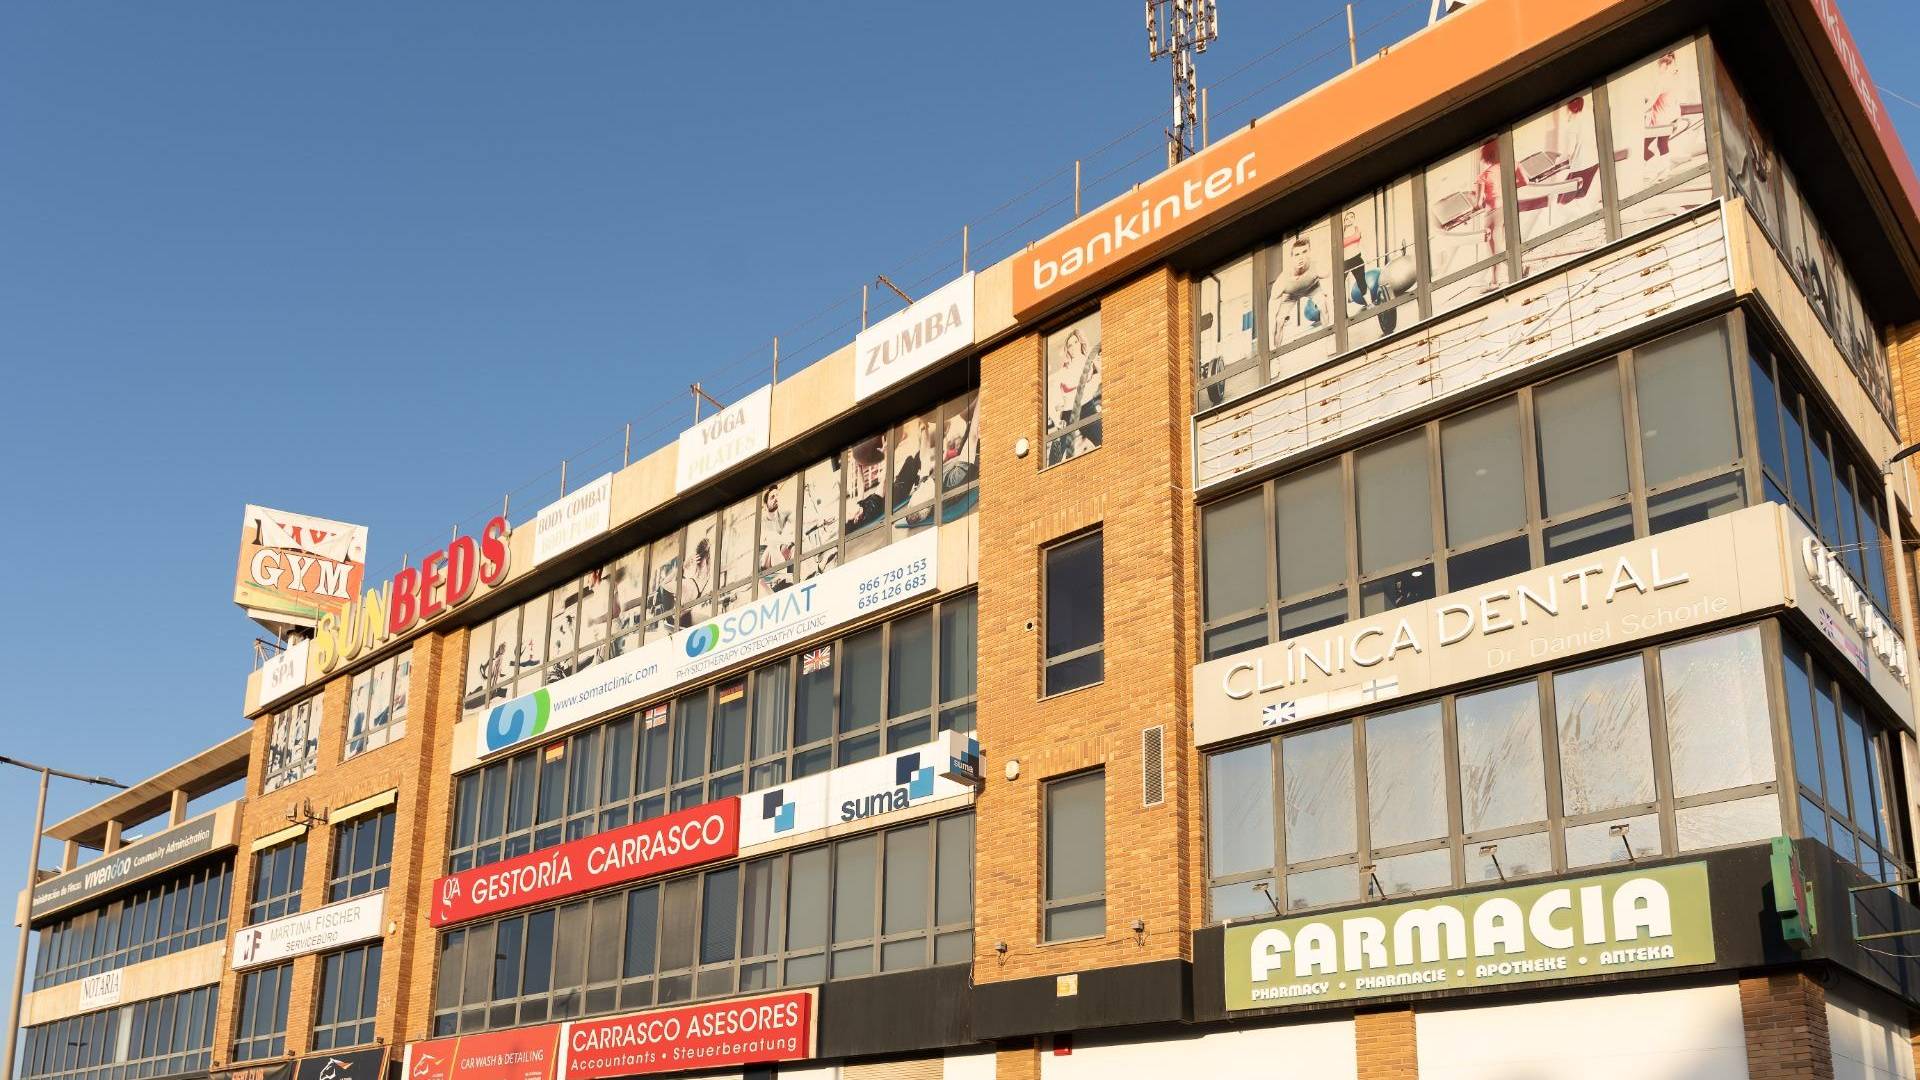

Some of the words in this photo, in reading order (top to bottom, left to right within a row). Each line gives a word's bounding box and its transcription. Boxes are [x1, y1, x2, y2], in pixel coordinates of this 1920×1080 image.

[1033, 151, 1257, 291] bankinter.
[865, 303, 963, 377] ZUMBA
[701, 407, 746, 445] YOGA
[688, 434, 755, 481] PILATES
[538, 508, 563, 534] BODY
[566, 483, 609, 519] COMBAT
[251, 548, 354, 600] GYM
[858, 592, 879, 609] 636
[881, 583, 902, 601] 126
[904, 574, 927, 591] 683
[859, 577, 880, 594] 966
[883, 568, 904, 585] 730
[906, 558, 927, 576] 153
[721, 583, 817, 643] SOMAT
[1223, 617, 1423, 700] CLÍNICA
[1437, 548, 1690, 647] DENTAL
[1487, 648, 1519, 670] Dr.
[1530, 624, 1612, 659] Daniel
[1621, 594, 1729, 635] Schorle
[676, 647, 738, 680] PHYSIOTHERAPY
[740, 629, 794, 656] OSTEOPATHY
[796, 615, 827, 635] CLINIC
[272, 660, 295, 688] SPA
[553, 662, 658, 713] www.somatclinic.com
[953, 758, 974, 773] suma
[841, 787, 909, 822] suma
[133, 847, 165, 867] Community
[165, 829, 210, 855] Administration
[471, 851, 572, 904] GESTORÍA
[587, 815, 725, 875] CARRASCO
[270, 920, 311, 941] MARTINA
[315, 906, 361, 930] FISCHER
[1250, 878, 1673, 982] FARMACIA
[1252, 982, 1329, 1001] PHARMACY
[1356, 968, 1446, 990] PHARMACIE
[1476, 957, 1567, 978] APOTHEKE
[572, 1018, 681, 1052] CARRASCO
[686, 1001, 799, 1039] ASESORES
[461, 1056, 474, 1070] CAR
[475, 1055, 496, 1068] WASH
[497, 1054, 503, 1066] &
[504, 1049, 544, 1064] DETAILING
[571, 1052, 656, 1072] Accountants
[673, 1036, 797, 1061] Steuerberatung
